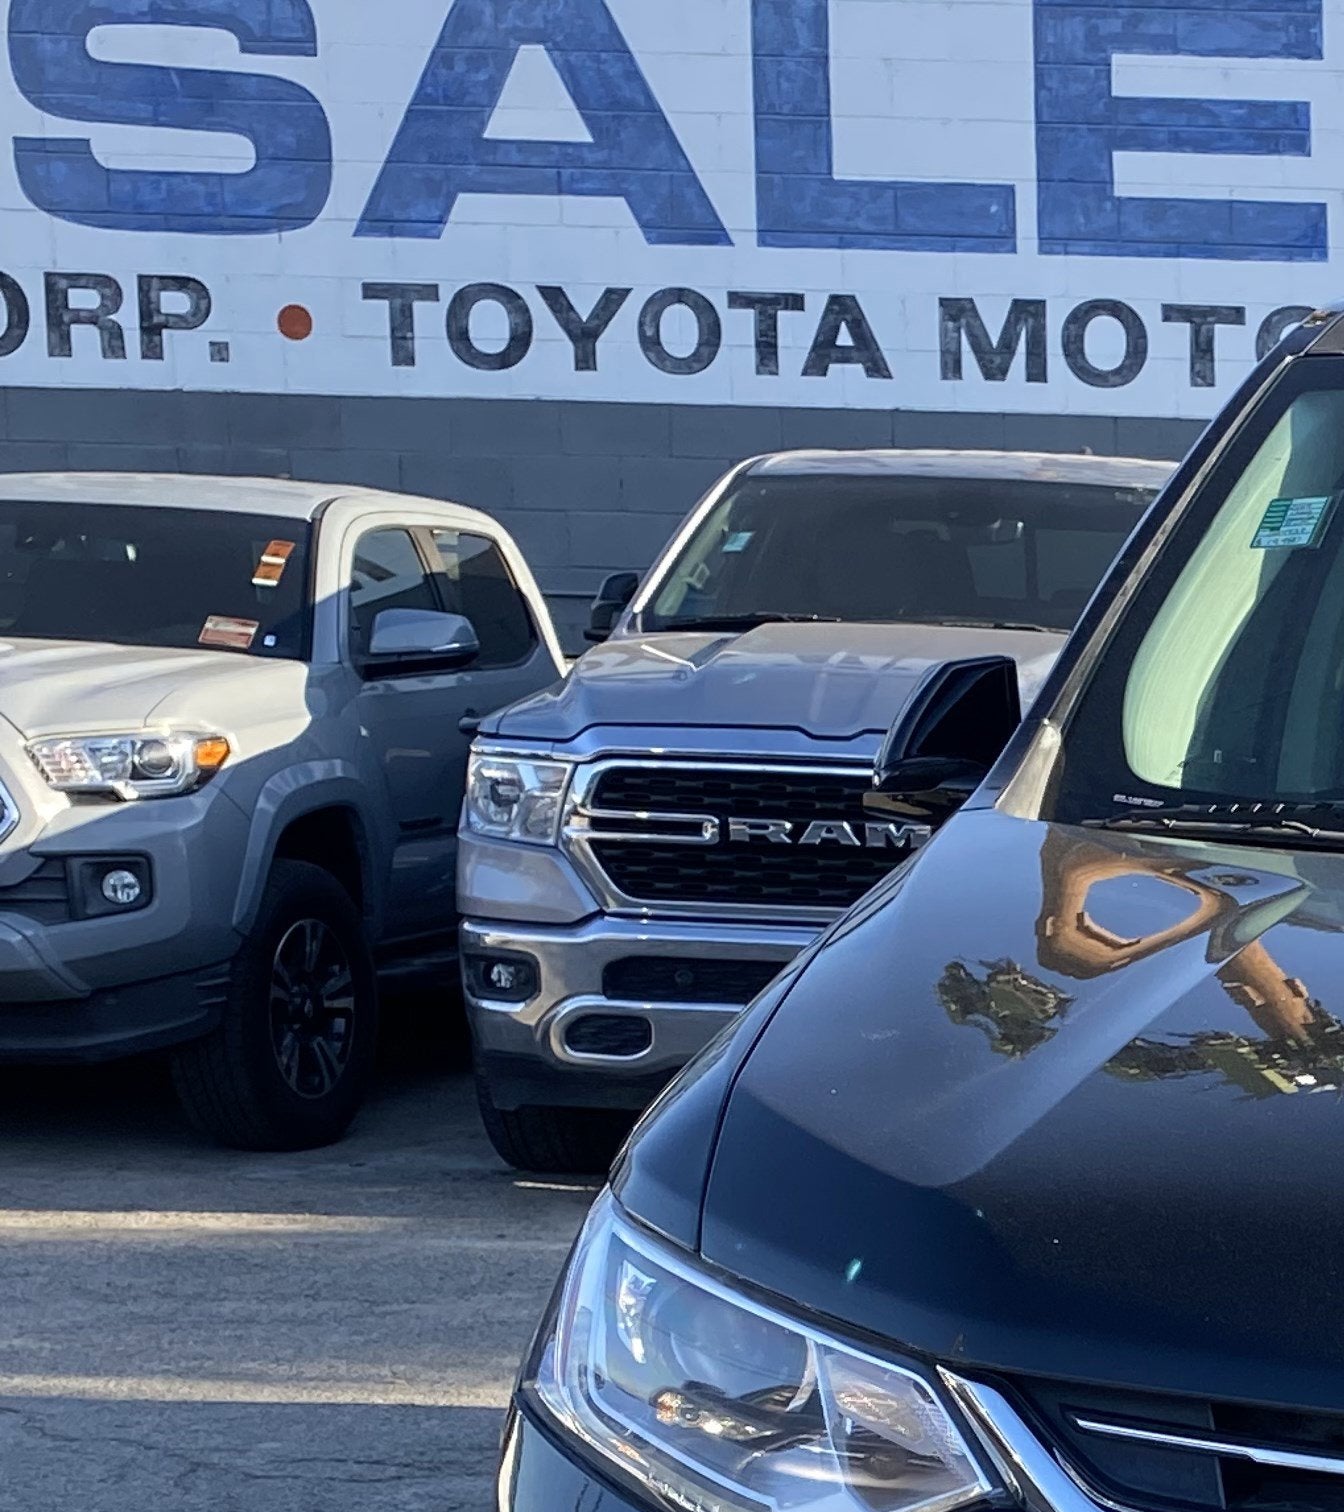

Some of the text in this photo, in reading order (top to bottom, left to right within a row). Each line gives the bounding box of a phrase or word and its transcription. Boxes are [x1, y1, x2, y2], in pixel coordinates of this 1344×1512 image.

[7, 0, 1328, 262] SALE
[361, 281, 893, 381] TOYOTA
[728, 815, 933, 848] RAM
